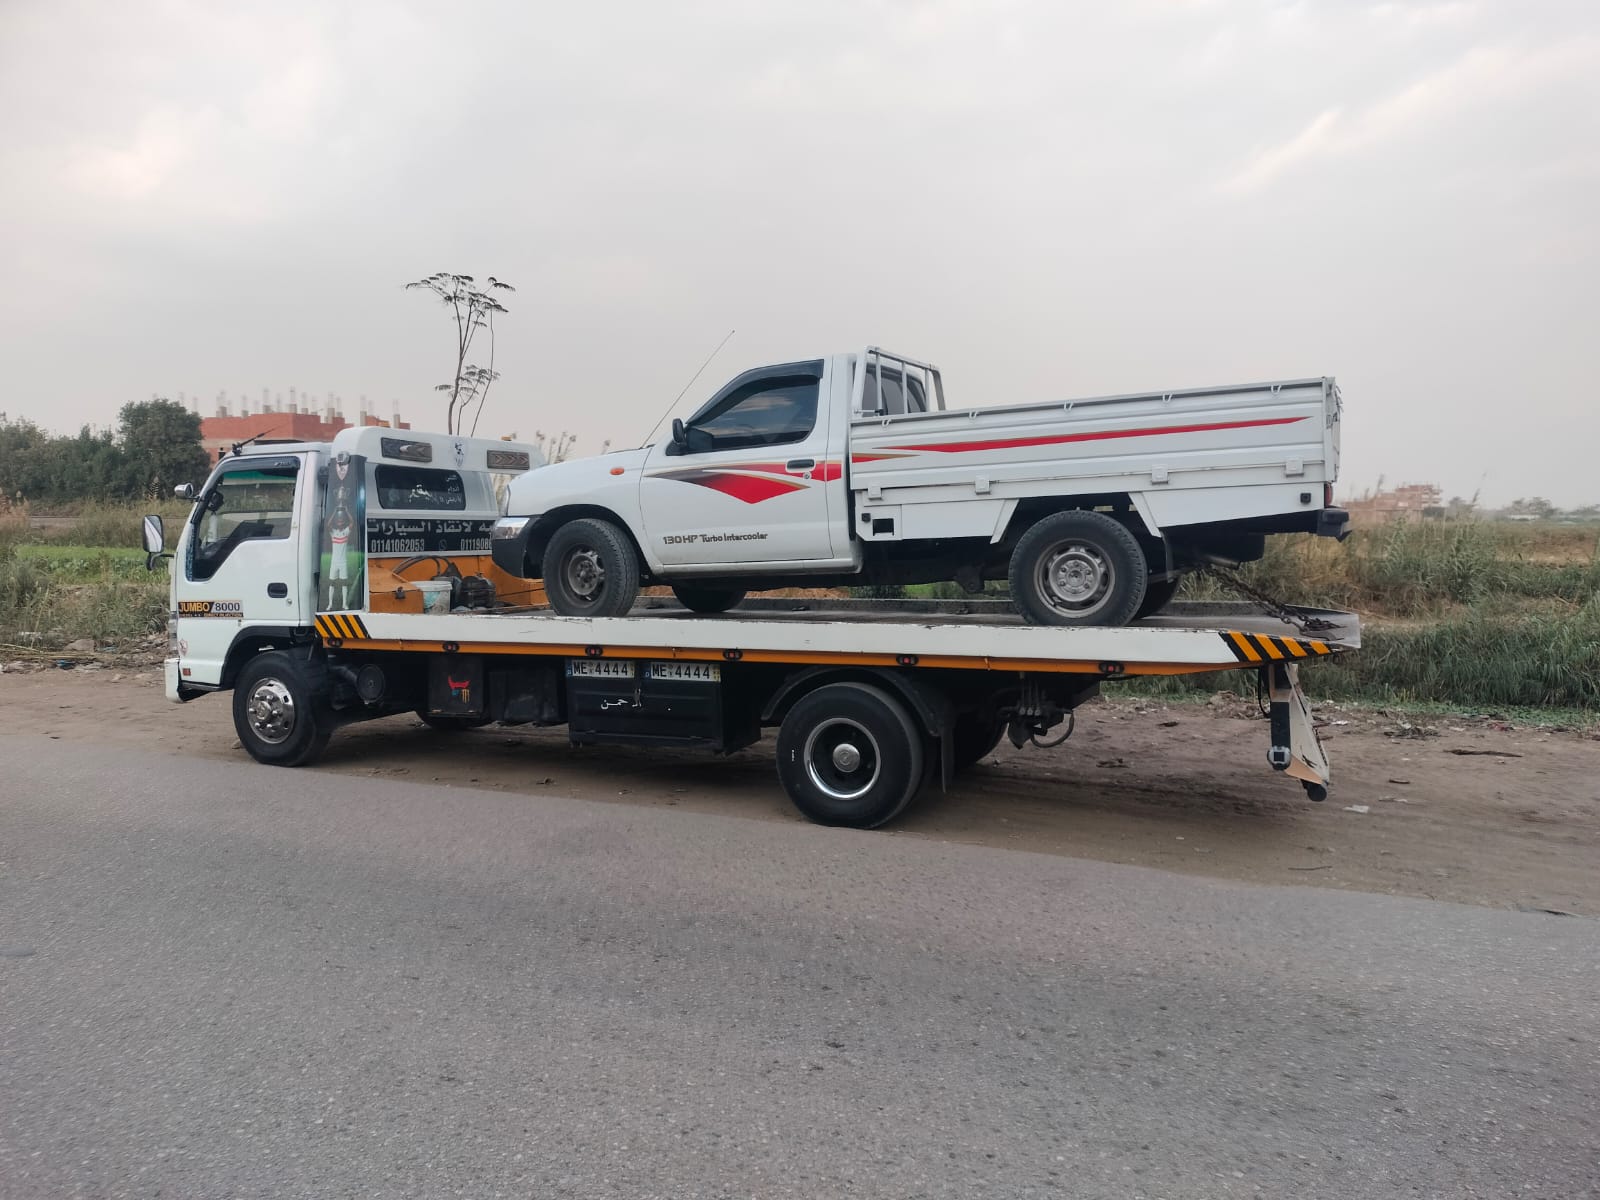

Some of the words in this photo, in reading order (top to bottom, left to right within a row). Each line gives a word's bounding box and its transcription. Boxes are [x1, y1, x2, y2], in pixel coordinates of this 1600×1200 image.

[367, 519, 431, 536] السيارات
[699, 534, 723, 543] Turbo
[724, 532, 768, 541] Intercooler
[371, 538, 425, 553] 01141062053
[179, 602, 210, 612] JUMBO
[215, 602, 240, 611] 8000
[573, 661, 588, 675] ME
[594, 662, 629, 676] 4444
[652, 664, 667, 678] ME
[675, 664, 710, 680] 4444
